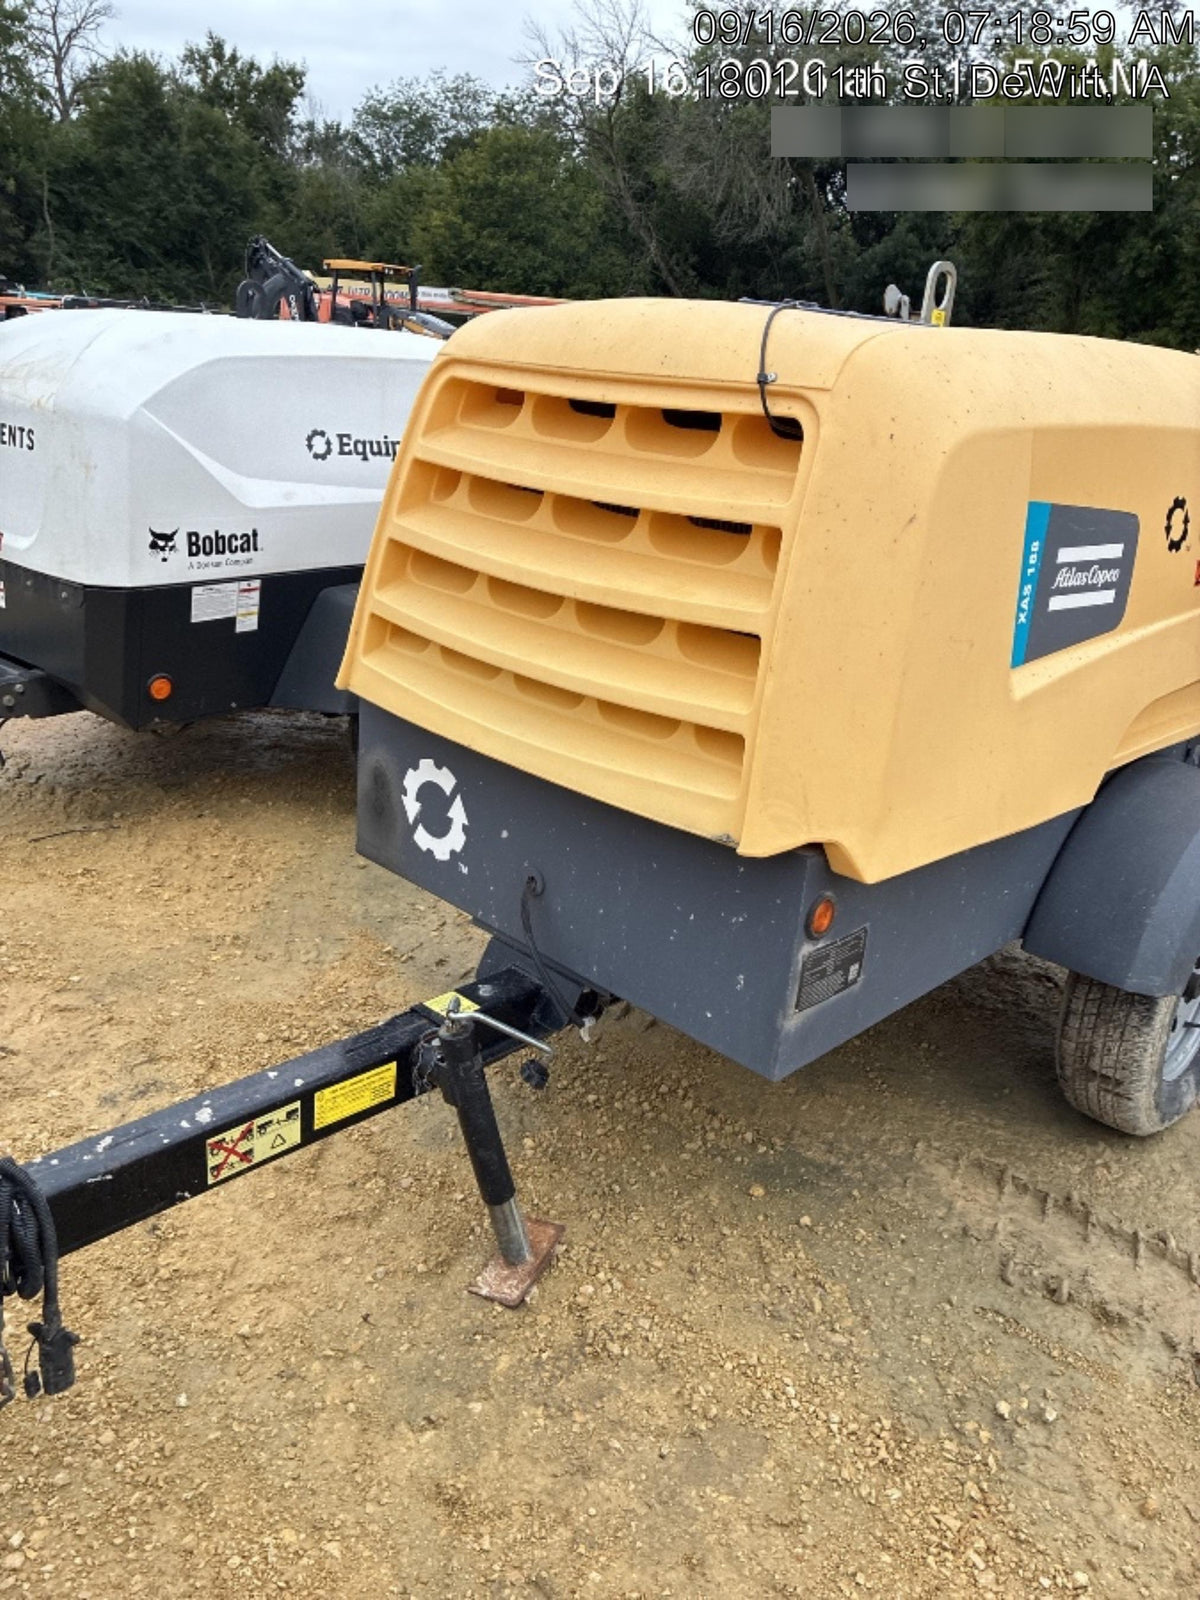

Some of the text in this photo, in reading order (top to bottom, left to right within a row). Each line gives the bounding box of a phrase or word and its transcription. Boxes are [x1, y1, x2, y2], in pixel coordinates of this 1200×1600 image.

[186, 528, 259, 557] Bobcat
[1017, 540, 1039, 624] XAS 188
